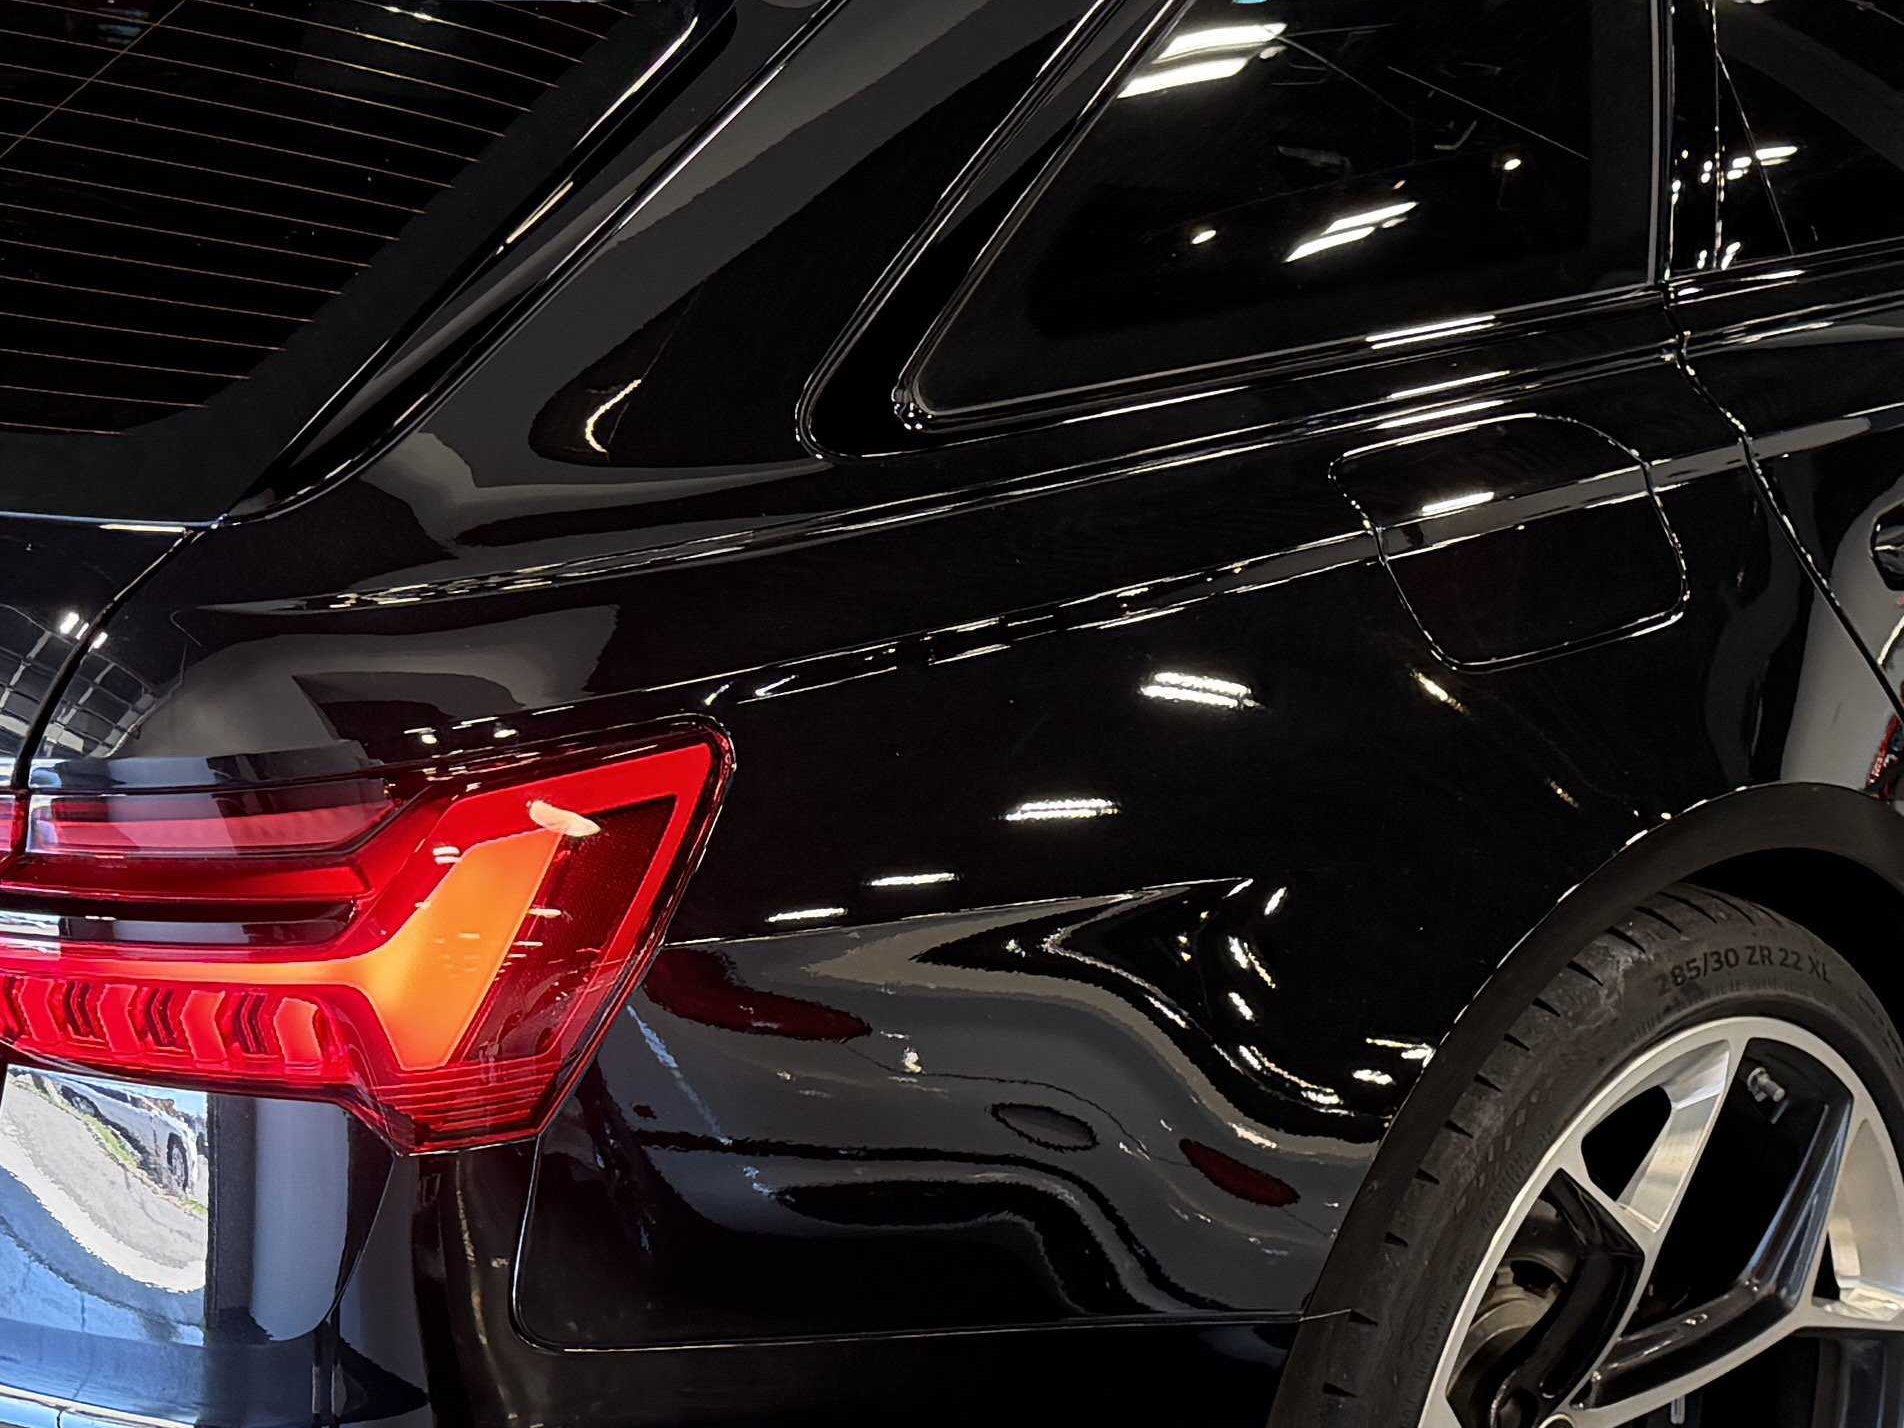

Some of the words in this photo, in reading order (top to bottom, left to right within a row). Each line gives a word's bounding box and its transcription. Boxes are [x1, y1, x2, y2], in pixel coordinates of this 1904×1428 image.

[1655, 947, 1740, 996] 285/30
[1745, 945, 1774, 966] ZR
[1779, 947, 1802, 971] 22
[1808, 954, 1832, 984] XL
